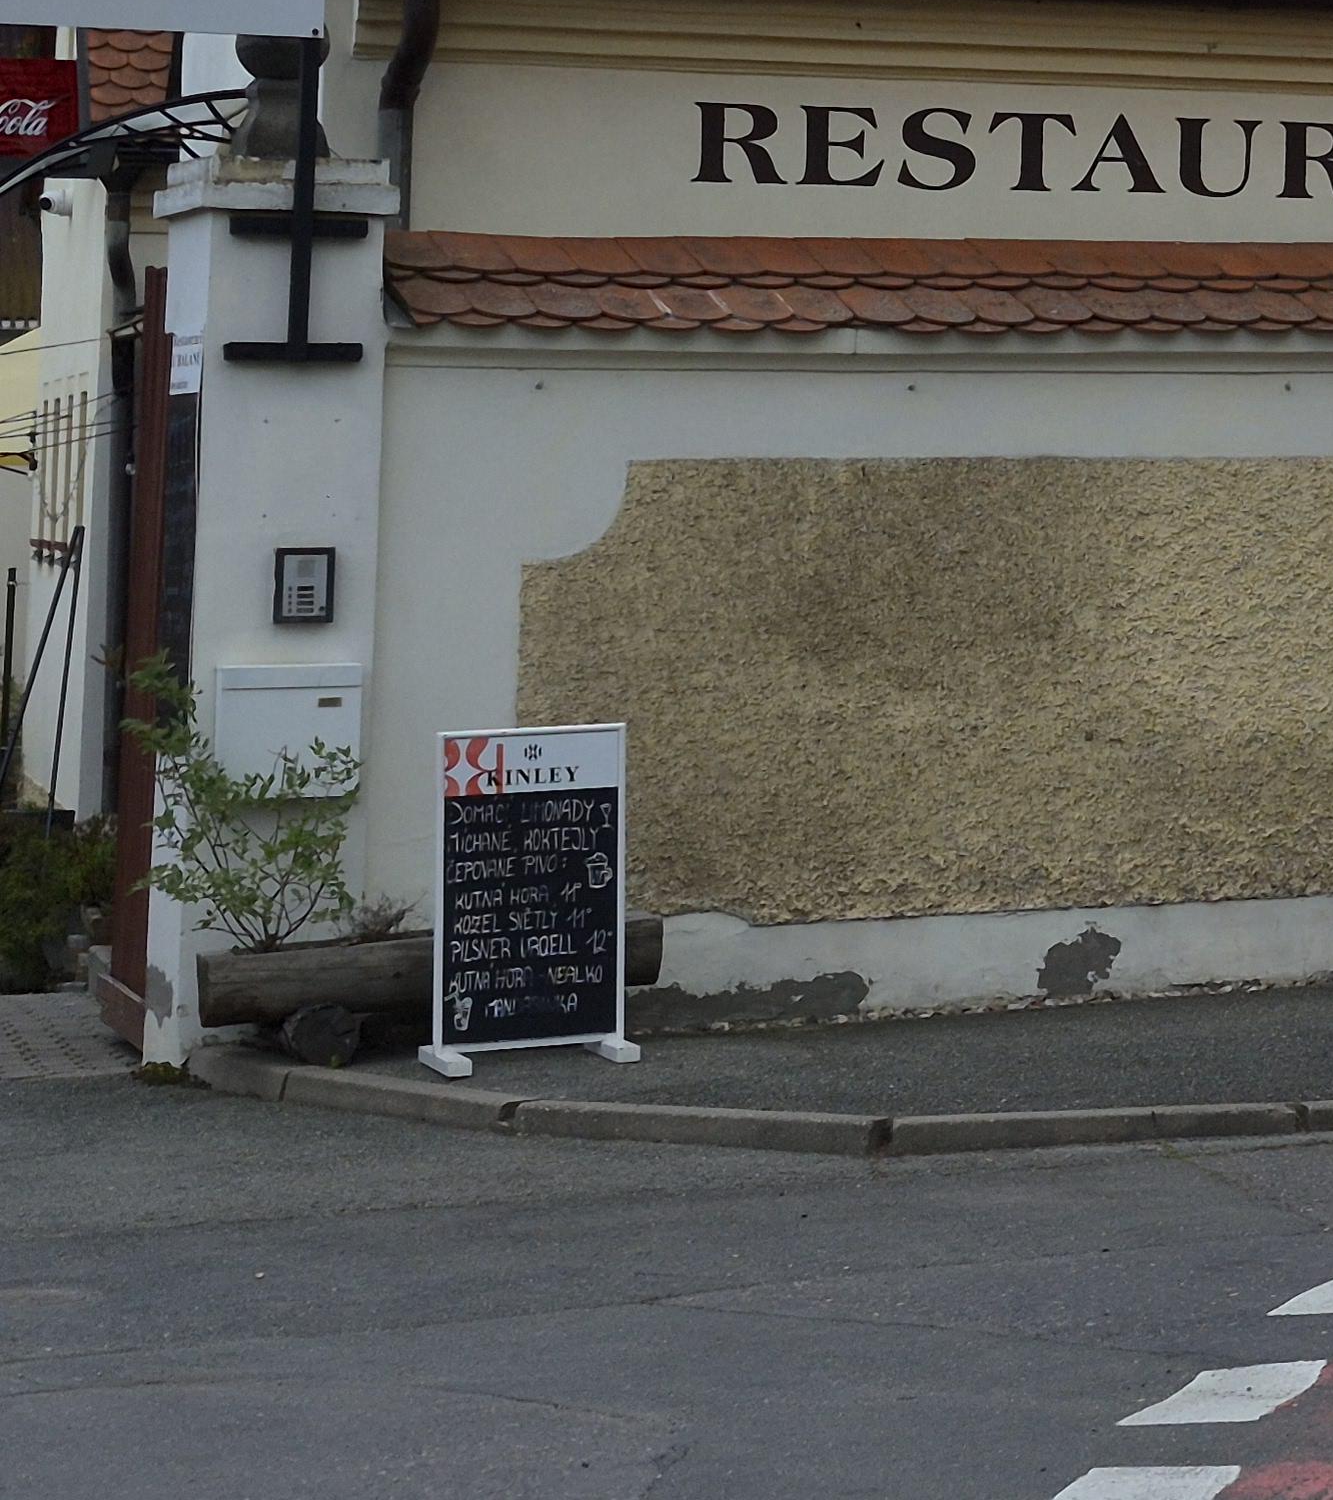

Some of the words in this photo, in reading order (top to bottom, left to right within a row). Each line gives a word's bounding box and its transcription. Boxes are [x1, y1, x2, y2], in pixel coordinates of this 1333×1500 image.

[486, 765, 580, 787] KINLEY
[524, 827, 600, 851] KOKTEJLY
[510, 885, 550, 906] HORA
[454, 913, 502, 935] KOZEL
[450, 937, 512, 963] PILSNER
